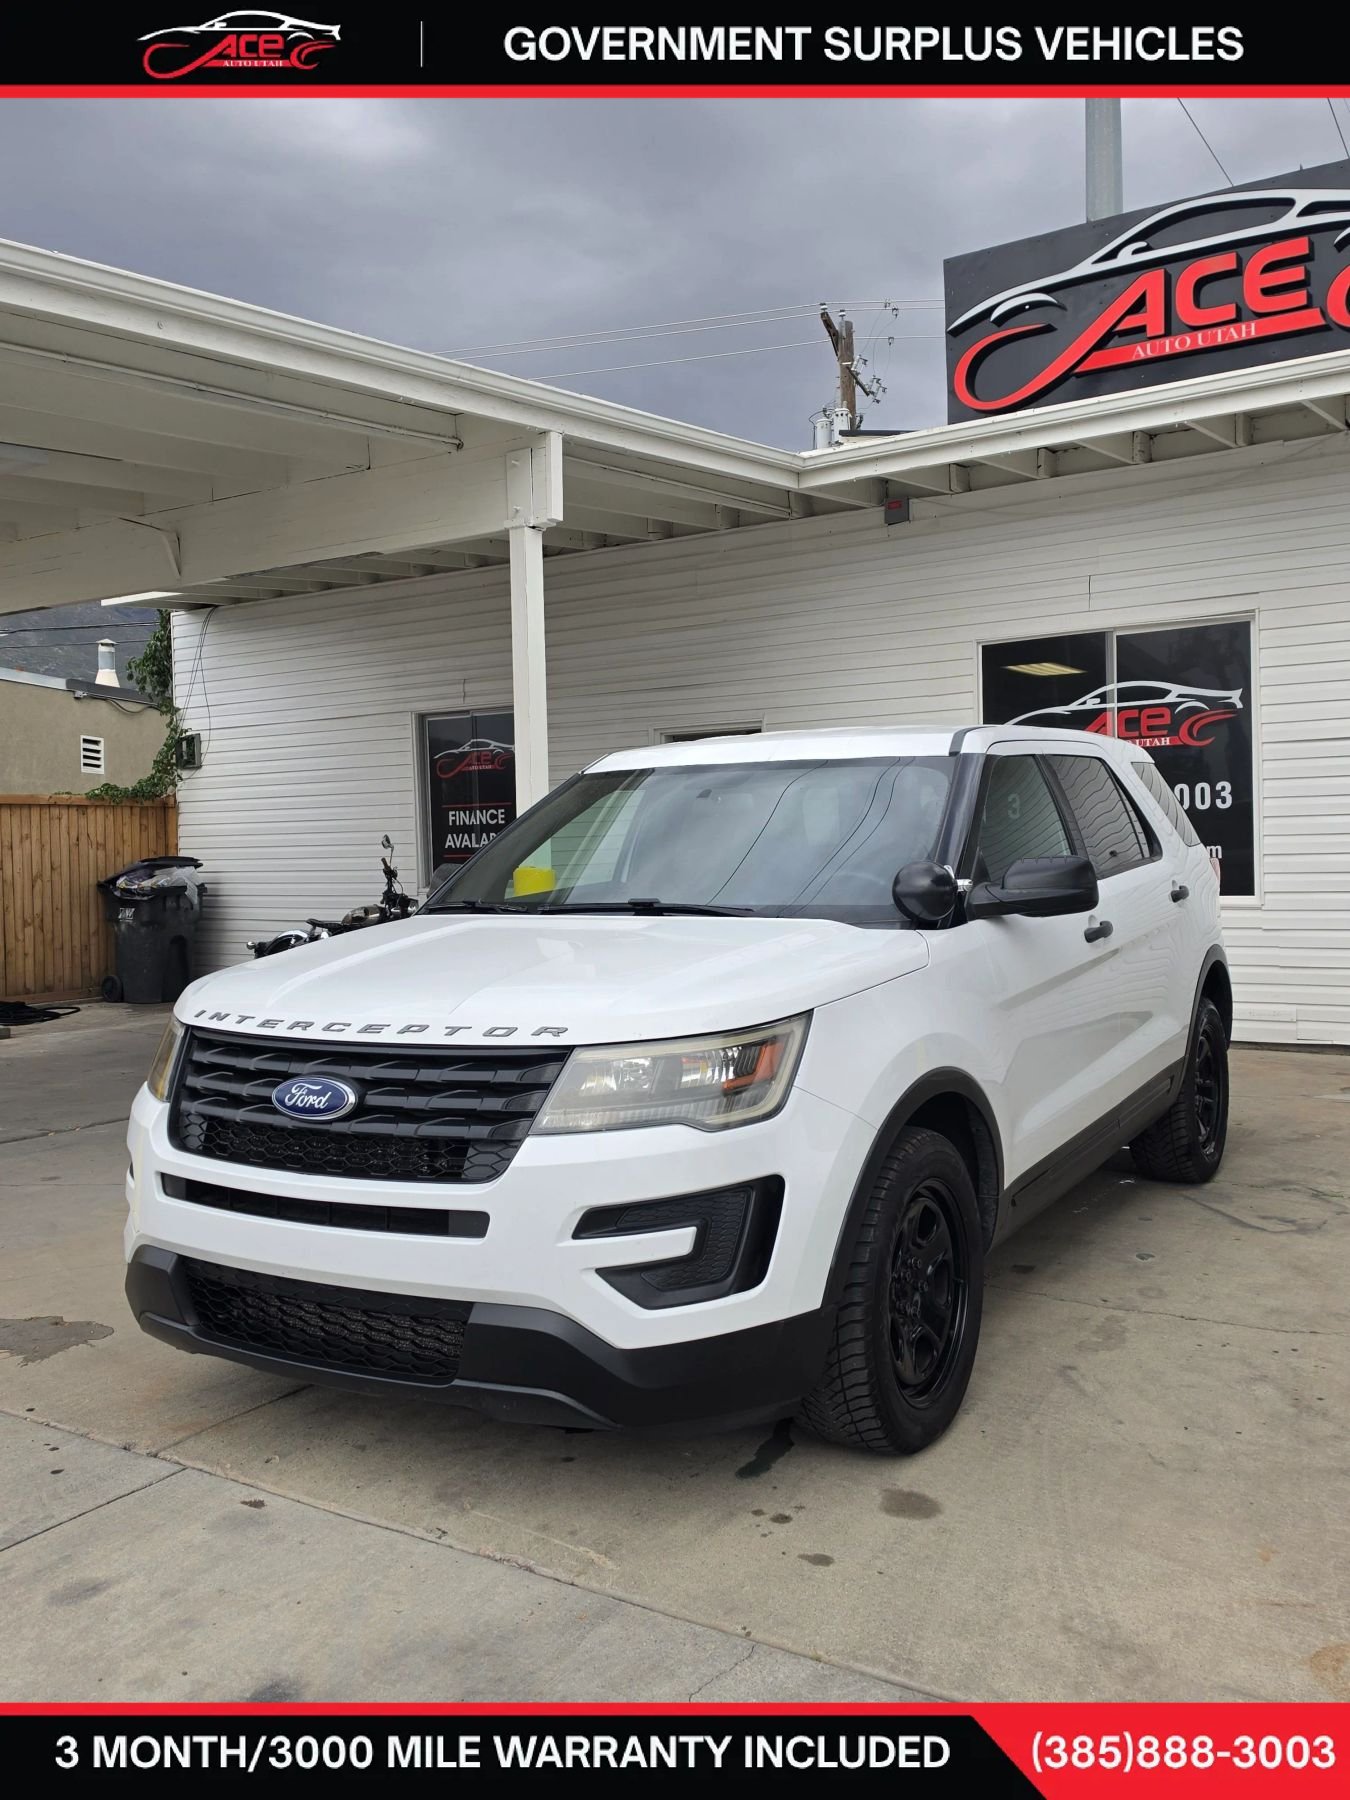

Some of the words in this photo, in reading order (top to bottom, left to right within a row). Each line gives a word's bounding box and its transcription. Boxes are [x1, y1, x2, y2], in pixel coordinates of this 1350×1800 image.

[1131, 334, 1191, 360] AUTO
[1198, 322, 1257, 347] UTAH
[448, 808, 506, 827] FINANCE
[194, 1009, 570, 1038] INTERCEPTOR
[284, 1084, 330, 1112] Ford
